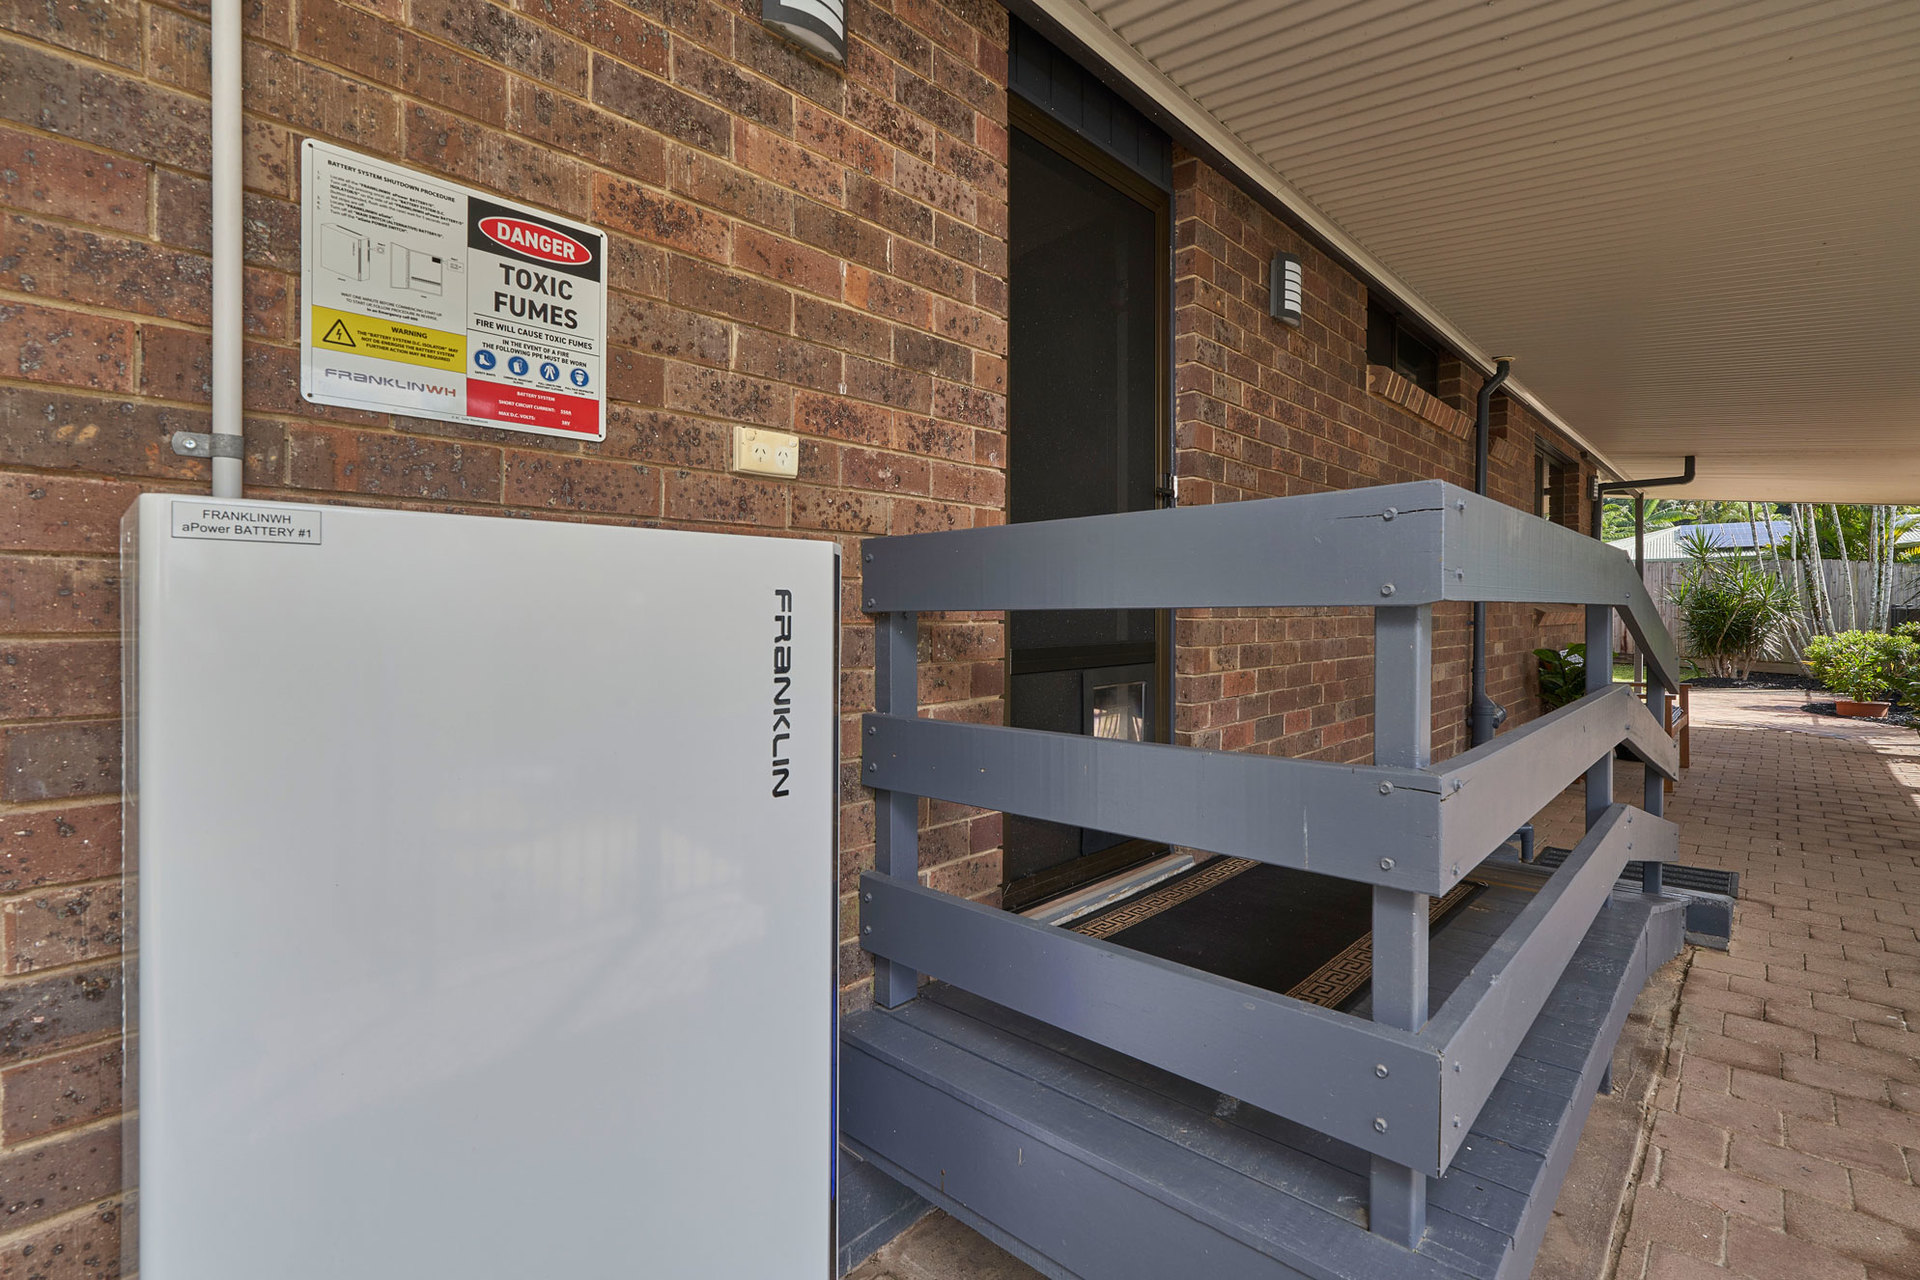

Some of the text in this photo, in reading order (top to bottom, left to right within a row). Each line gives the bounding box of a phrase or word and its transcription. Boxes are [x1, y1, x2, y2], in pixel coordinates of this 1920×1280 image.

[328, 159, 455, 203] BATTERY SYSTEM SHUTDOWN PROCEDURE
[497, 222, 575, 260] DANGER
[499, 263, 573, 301] TOXIC
[494, 291, 578, 330] FUMES
[392, 327, 427, 339] WARNING
[476, 319, 592, 350] FIRE WILL CAUSE TOXIC FUMES
[482, 342, 494, 350] THE
[496, 345, 531, 357] FOLLOWING
[544, 354, 560, 362] MUST
[570, 359, 586, 368] WORN
[524, 343, 541, 352] EVENT
[557, 350, 569, 358] FIRE
[517, 391, 537, 399] BATTERY
[202, 509, 291, 524] FRANKLINWH
[182, 522, 312, 538] aPower BATTERY #1
